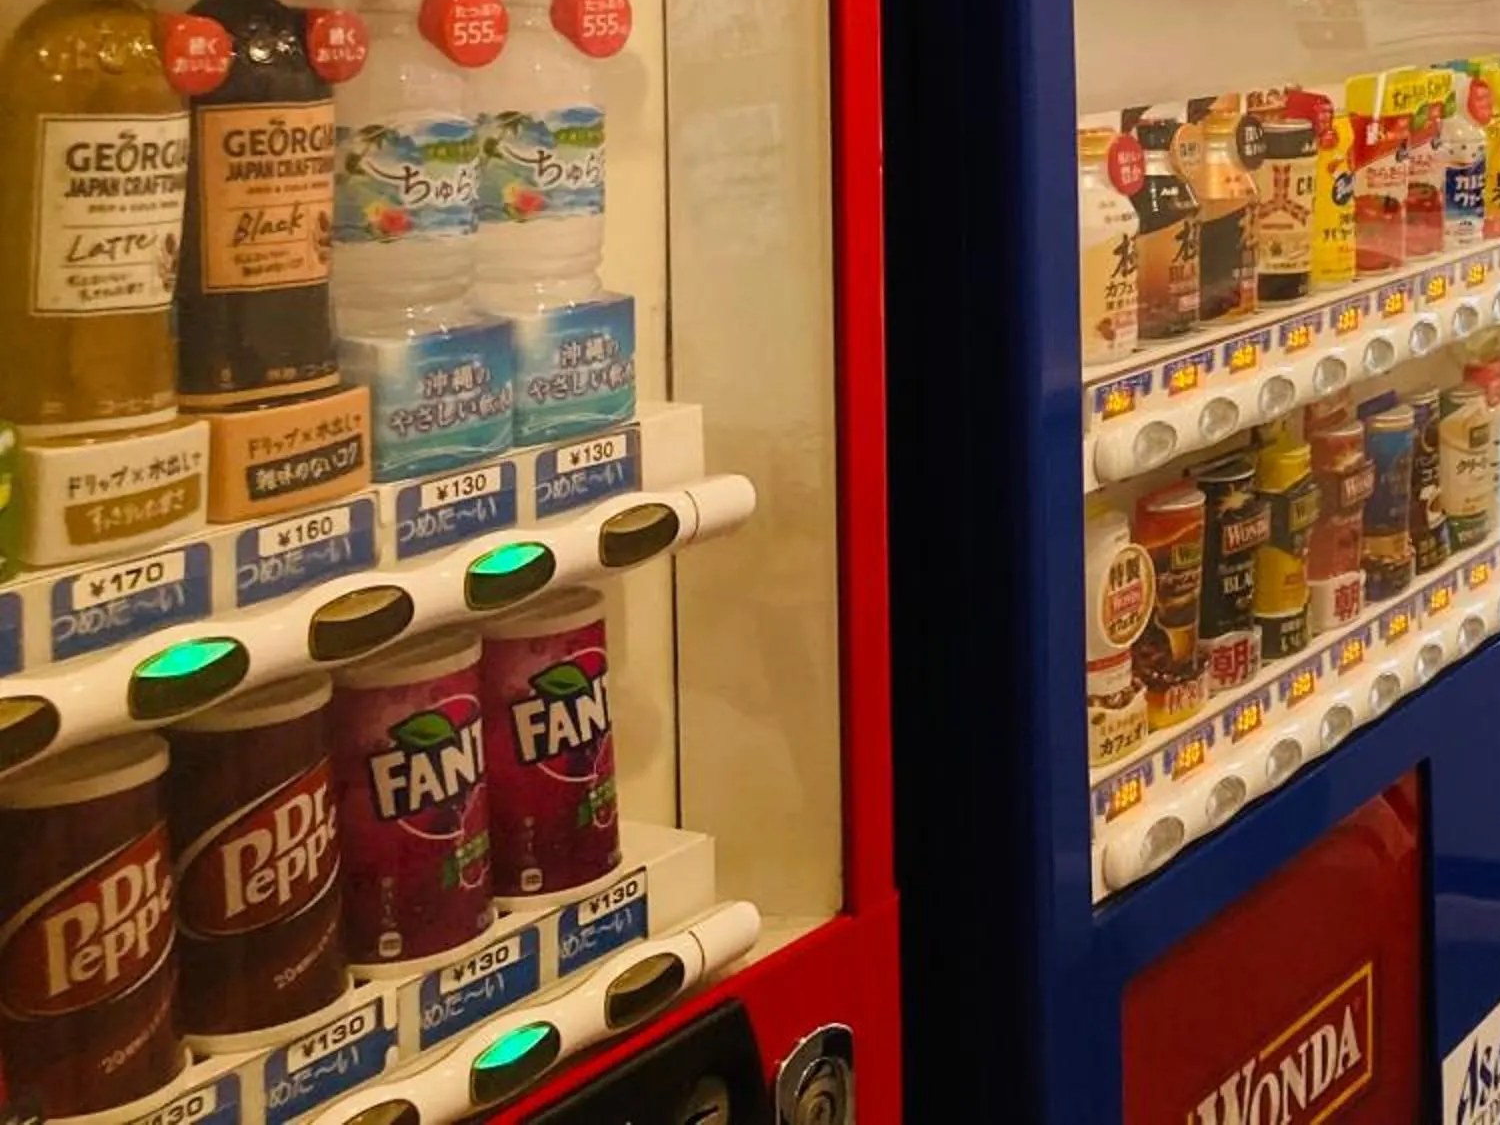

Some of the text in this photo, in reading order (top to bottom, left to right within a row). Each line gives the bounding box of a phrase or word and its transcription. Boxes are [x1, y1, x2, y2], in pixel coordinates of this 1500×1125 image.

[569, 441, 614, 466] ¥130
[436, 475, 487, 501] ¥130
[277, 516, 333, 547] ¥160
[90, 562, 164, 597] ¥170
[273, 781, 329, 856] Dr
[100, 851, 162, 932] Dr
[589, 880, 639, 914] ¥130
[453, 945, 510, 982] ¥130
[301, 1014, 367, 1059] ¥130
[1197, 1004, 1362, 1125] WONDA
